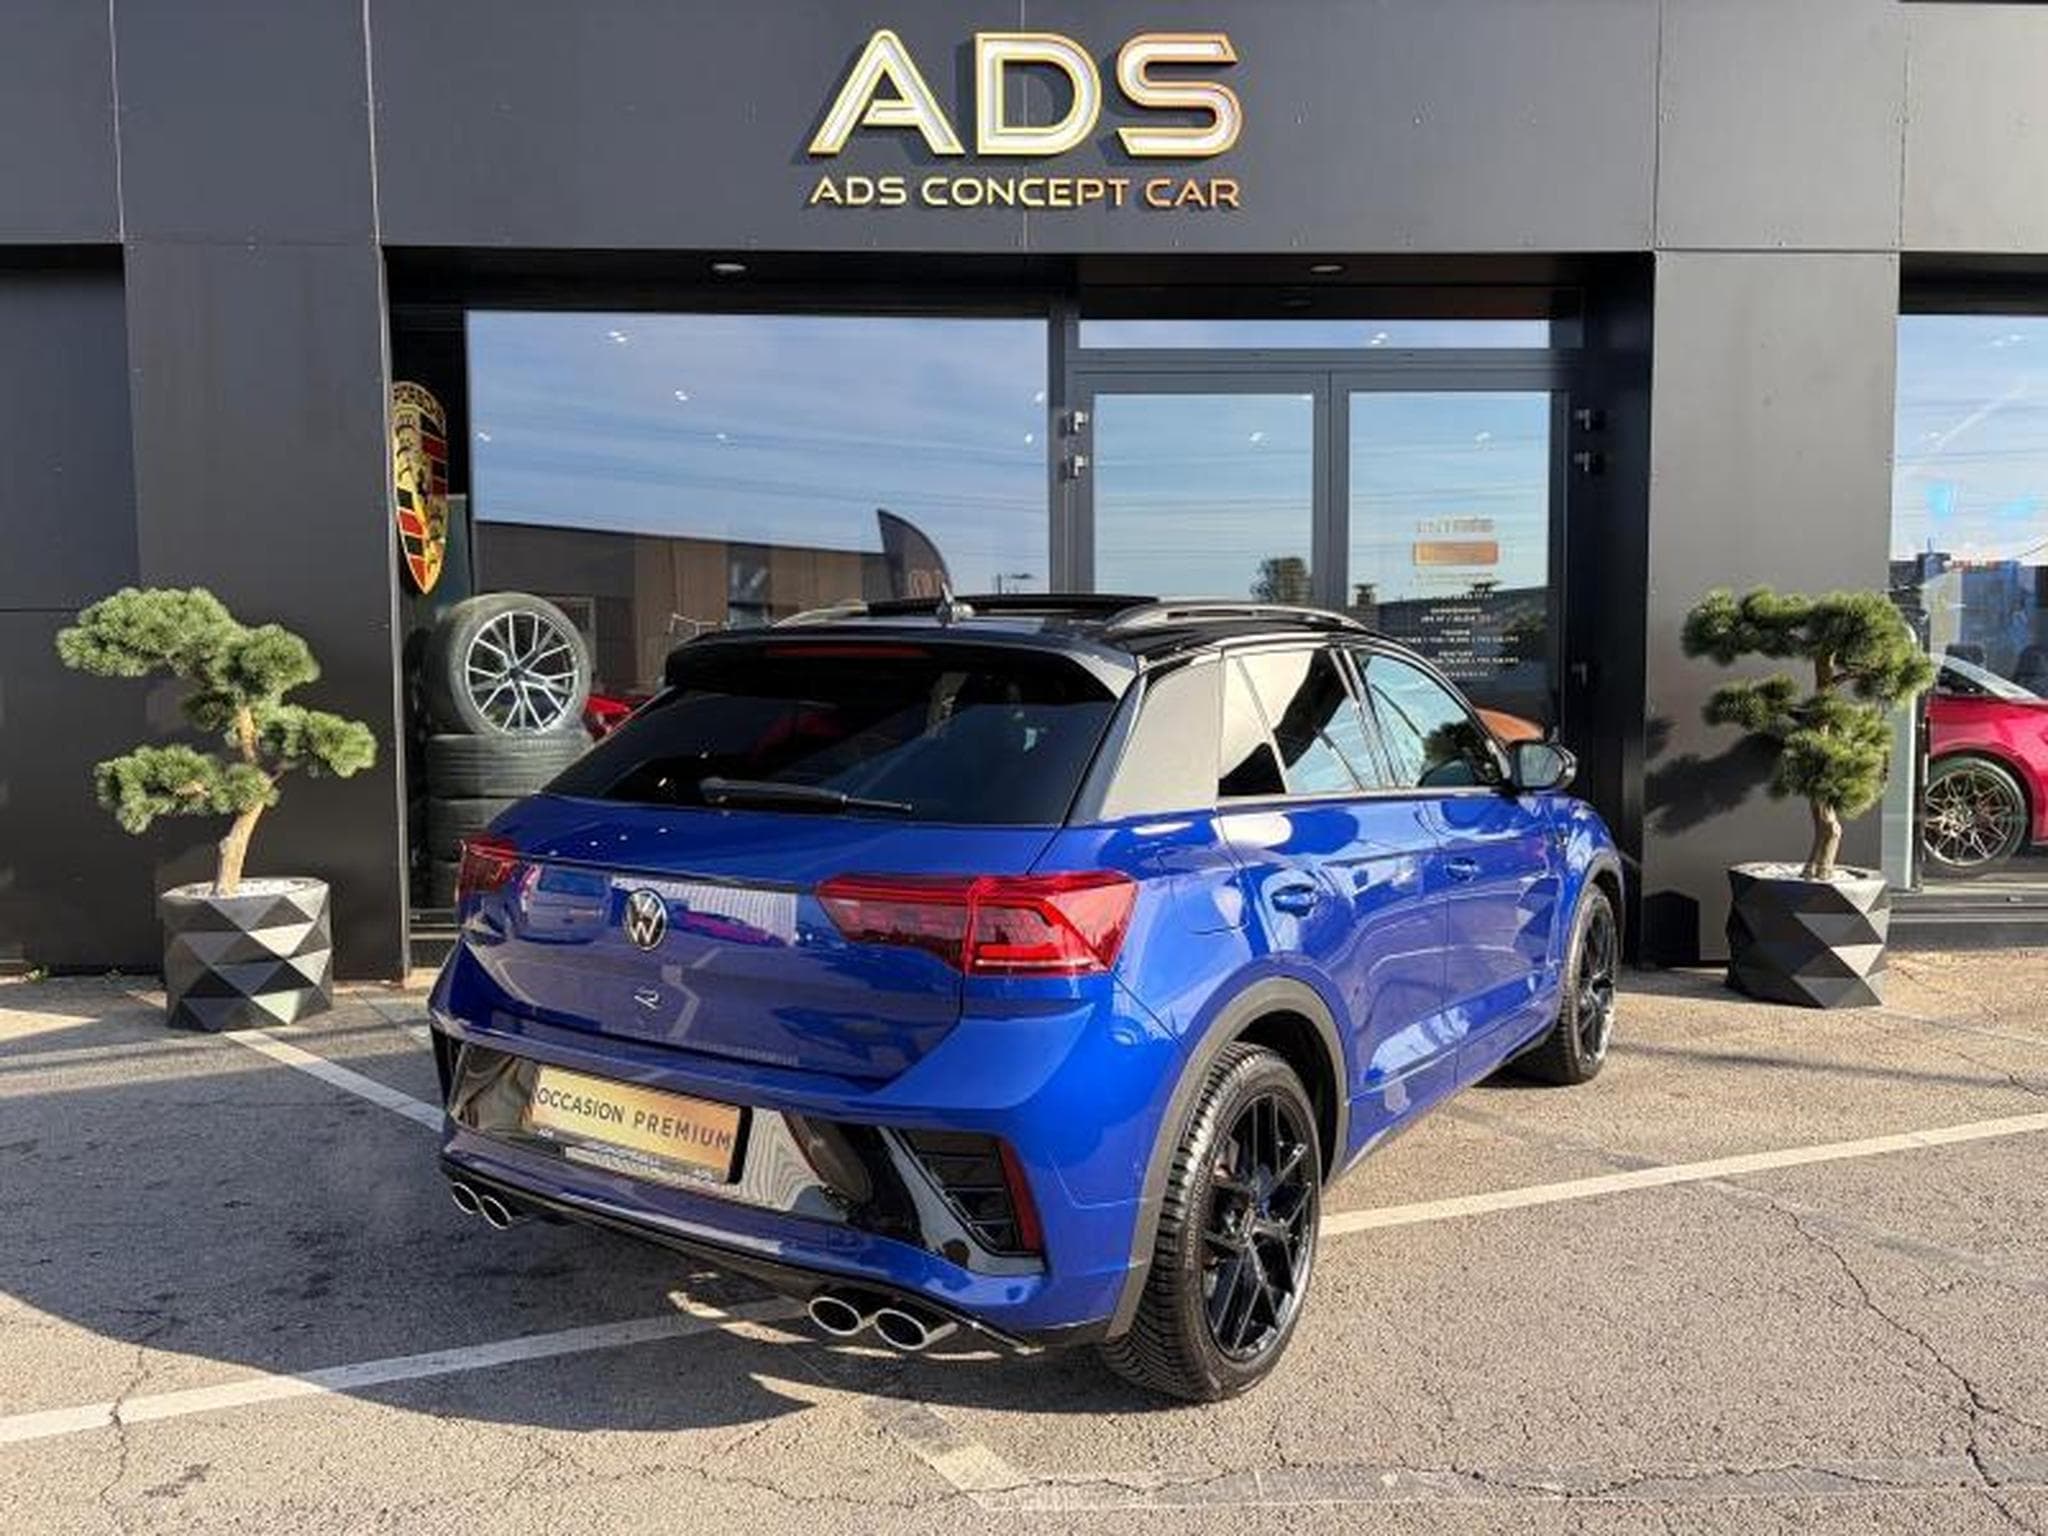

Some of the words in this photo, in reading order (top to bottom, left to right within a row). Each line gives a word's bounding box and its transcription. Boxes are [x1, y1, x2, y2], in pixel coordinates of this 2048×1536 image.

[808, 29, 1243, 156] ADS
[809, 177, 907, 207] ADS
[921, 177, 1130, 207] CONCEPT
[1145, 178, 1240, 207] CAR
[537, 1086, 625, 1124] OCCASION
[633, 1110, 731, 1150] PREMIUM
